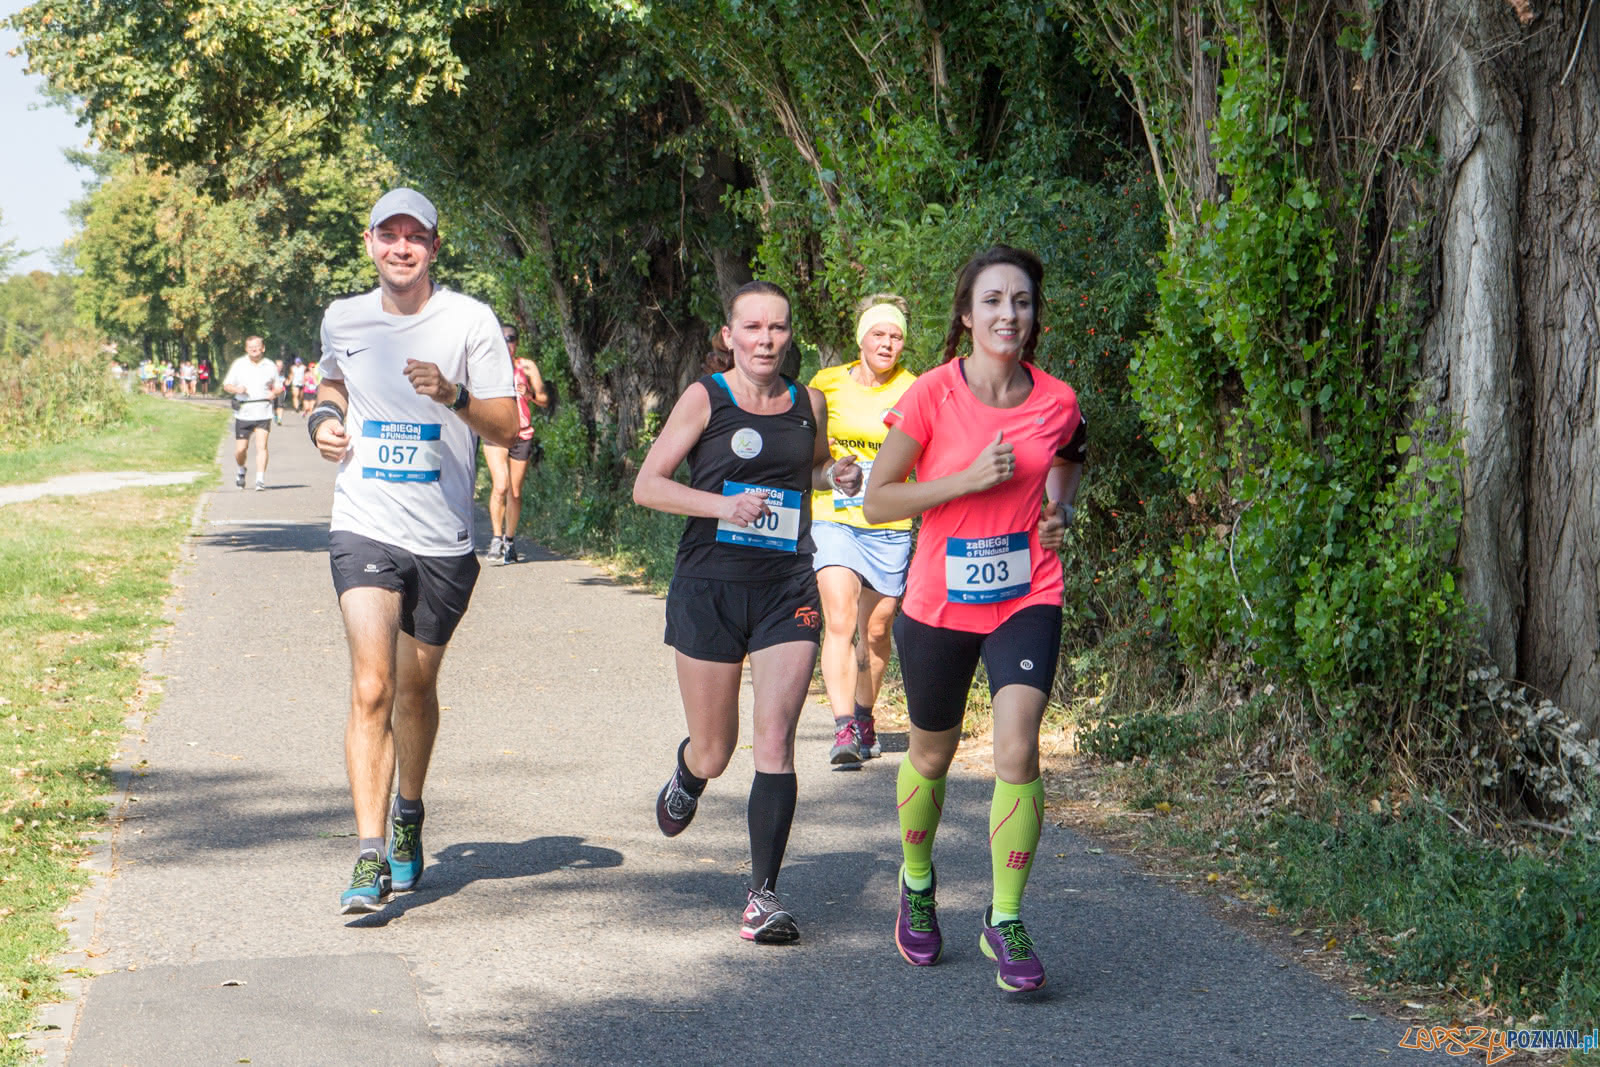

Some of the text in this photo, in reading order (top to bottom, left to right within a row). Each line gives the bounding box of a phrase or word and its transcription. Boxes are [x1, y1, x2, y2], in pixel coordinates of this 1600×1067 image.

[381, 423, 421, 436] zaBIEGaj
[378, 445, 419, 464] 057
[754, 511, 779, 531] 00
[966, 536, 1009, 550] zaBIEGaj
[974, 546, 1009, 557] FUNdusze
[966, 560, 1009, 584] 203
[1006, 862, 1025, 870] cep
